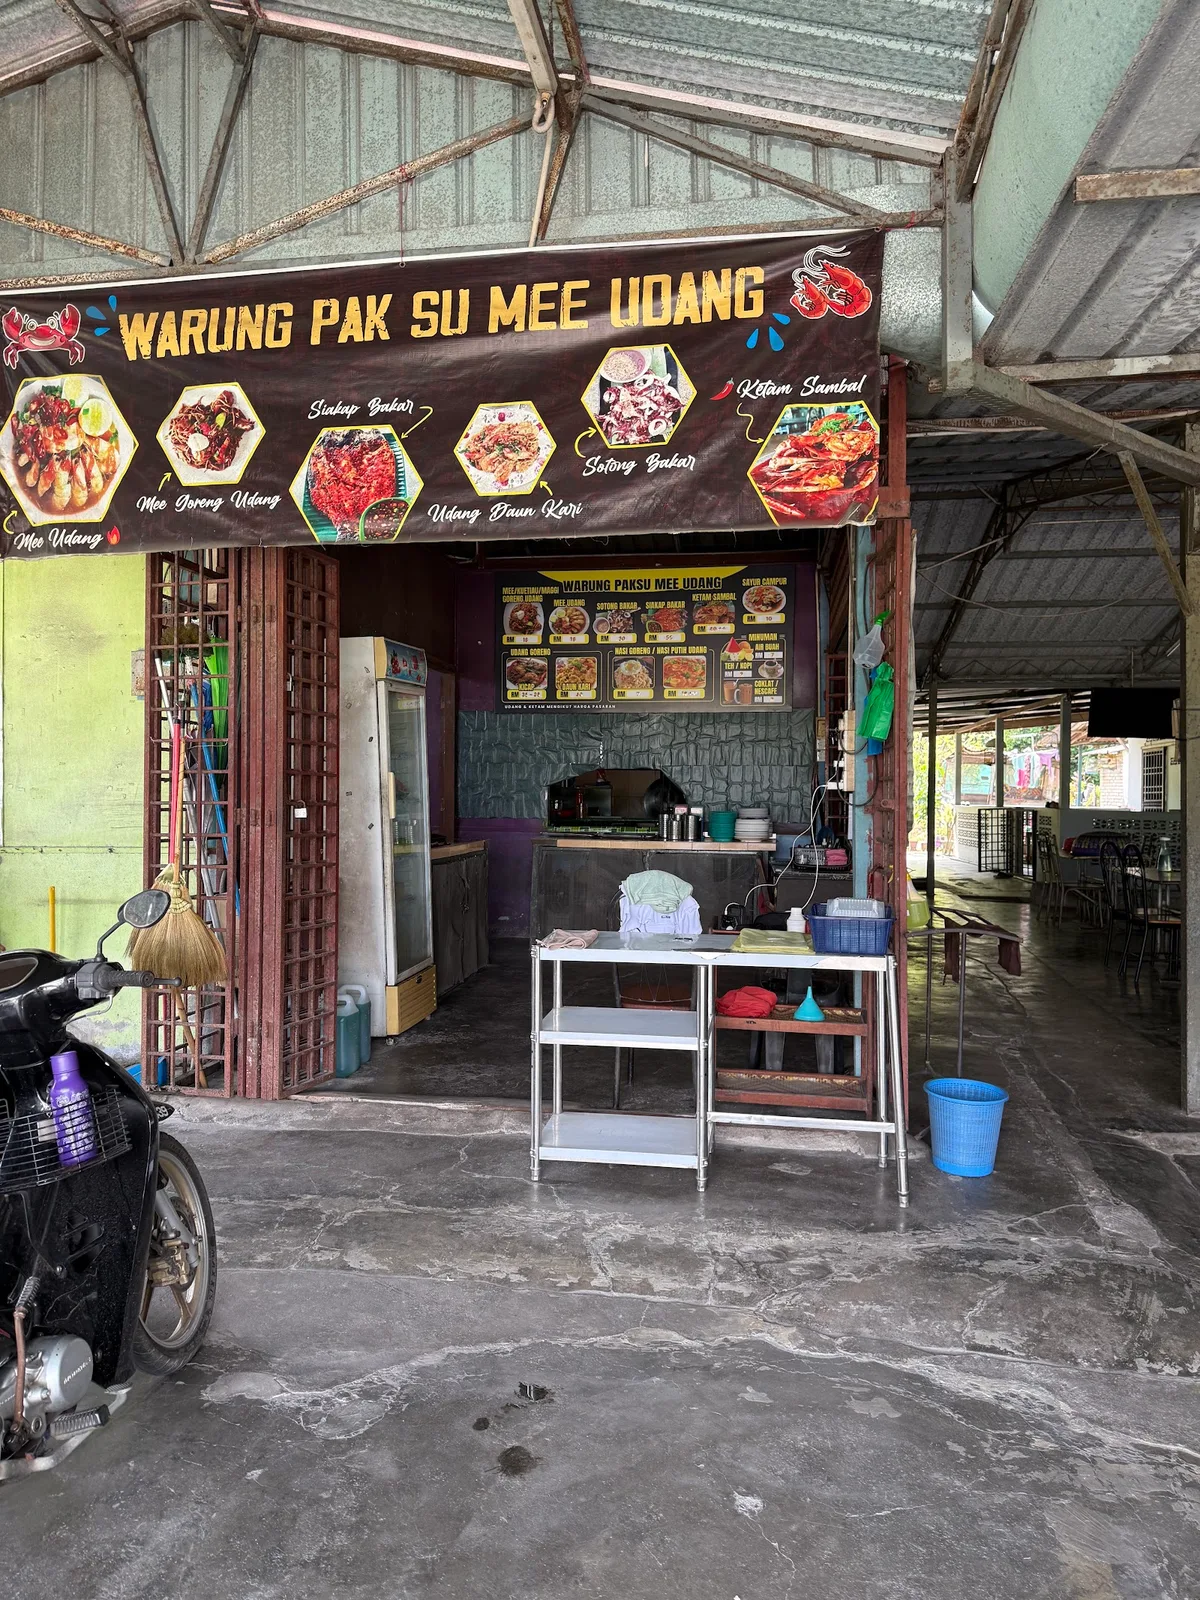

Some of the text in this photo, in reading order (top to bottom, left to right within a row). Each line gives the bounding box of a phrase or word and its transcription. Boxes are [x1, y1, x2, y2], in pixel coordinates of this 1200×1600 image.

[118, 266, 765, 362] WARUNG PAK SU MEE UDANG
[736, 375, 868, 399] Ketam Sambal
[307, 397, 414, 421] Siakap Bakar
[582, 453, 696, 477] Sotong Bakar
[136, 490, 282, 513] Mee Goreng Udang
[428, 499, 583, 525] Udang Daun Kari
[13, 528, 104, 551] Mee Udang
[562, 576, 722, 593] WARUNG PAKSU MEE UDANG
[742, 578, 787, 586] SAYUR CAMPUR
[502, 594, 543, 603] GORENG UDANG
[692, 592, 737, 601] KETAM SAMBAL
[553, 598, 585, 607] MEE UDANG
[596, 602, 638, 610] SOTONG BAKAR
[645, 601, 686, 609] SIAKAP BAKAR
[697, 625, 706, 633] RM
[553, 635, 562, 643] RM
[748, 633, 778, 641] MINUMAN
[614, 647, 628, 655] NASI
[628, 646, 651, 655] GORENG
[656, 647, 670, 655] NASI
[670, 646, 687, 654] PUTIH
[687, 646, 708, 654] UDANG
[755, 643, 764, 651] AIR
[510, 648, 551, 656] UDANG GORENG
[518, 683, 535, 691] KICAP
[562, 683, 591, 691] DAUN KARI
[754, 680, 774, 688] COKLAT
[667, 690, 677, 698] RM
[754, 687, 778, 695] NESCAFE
